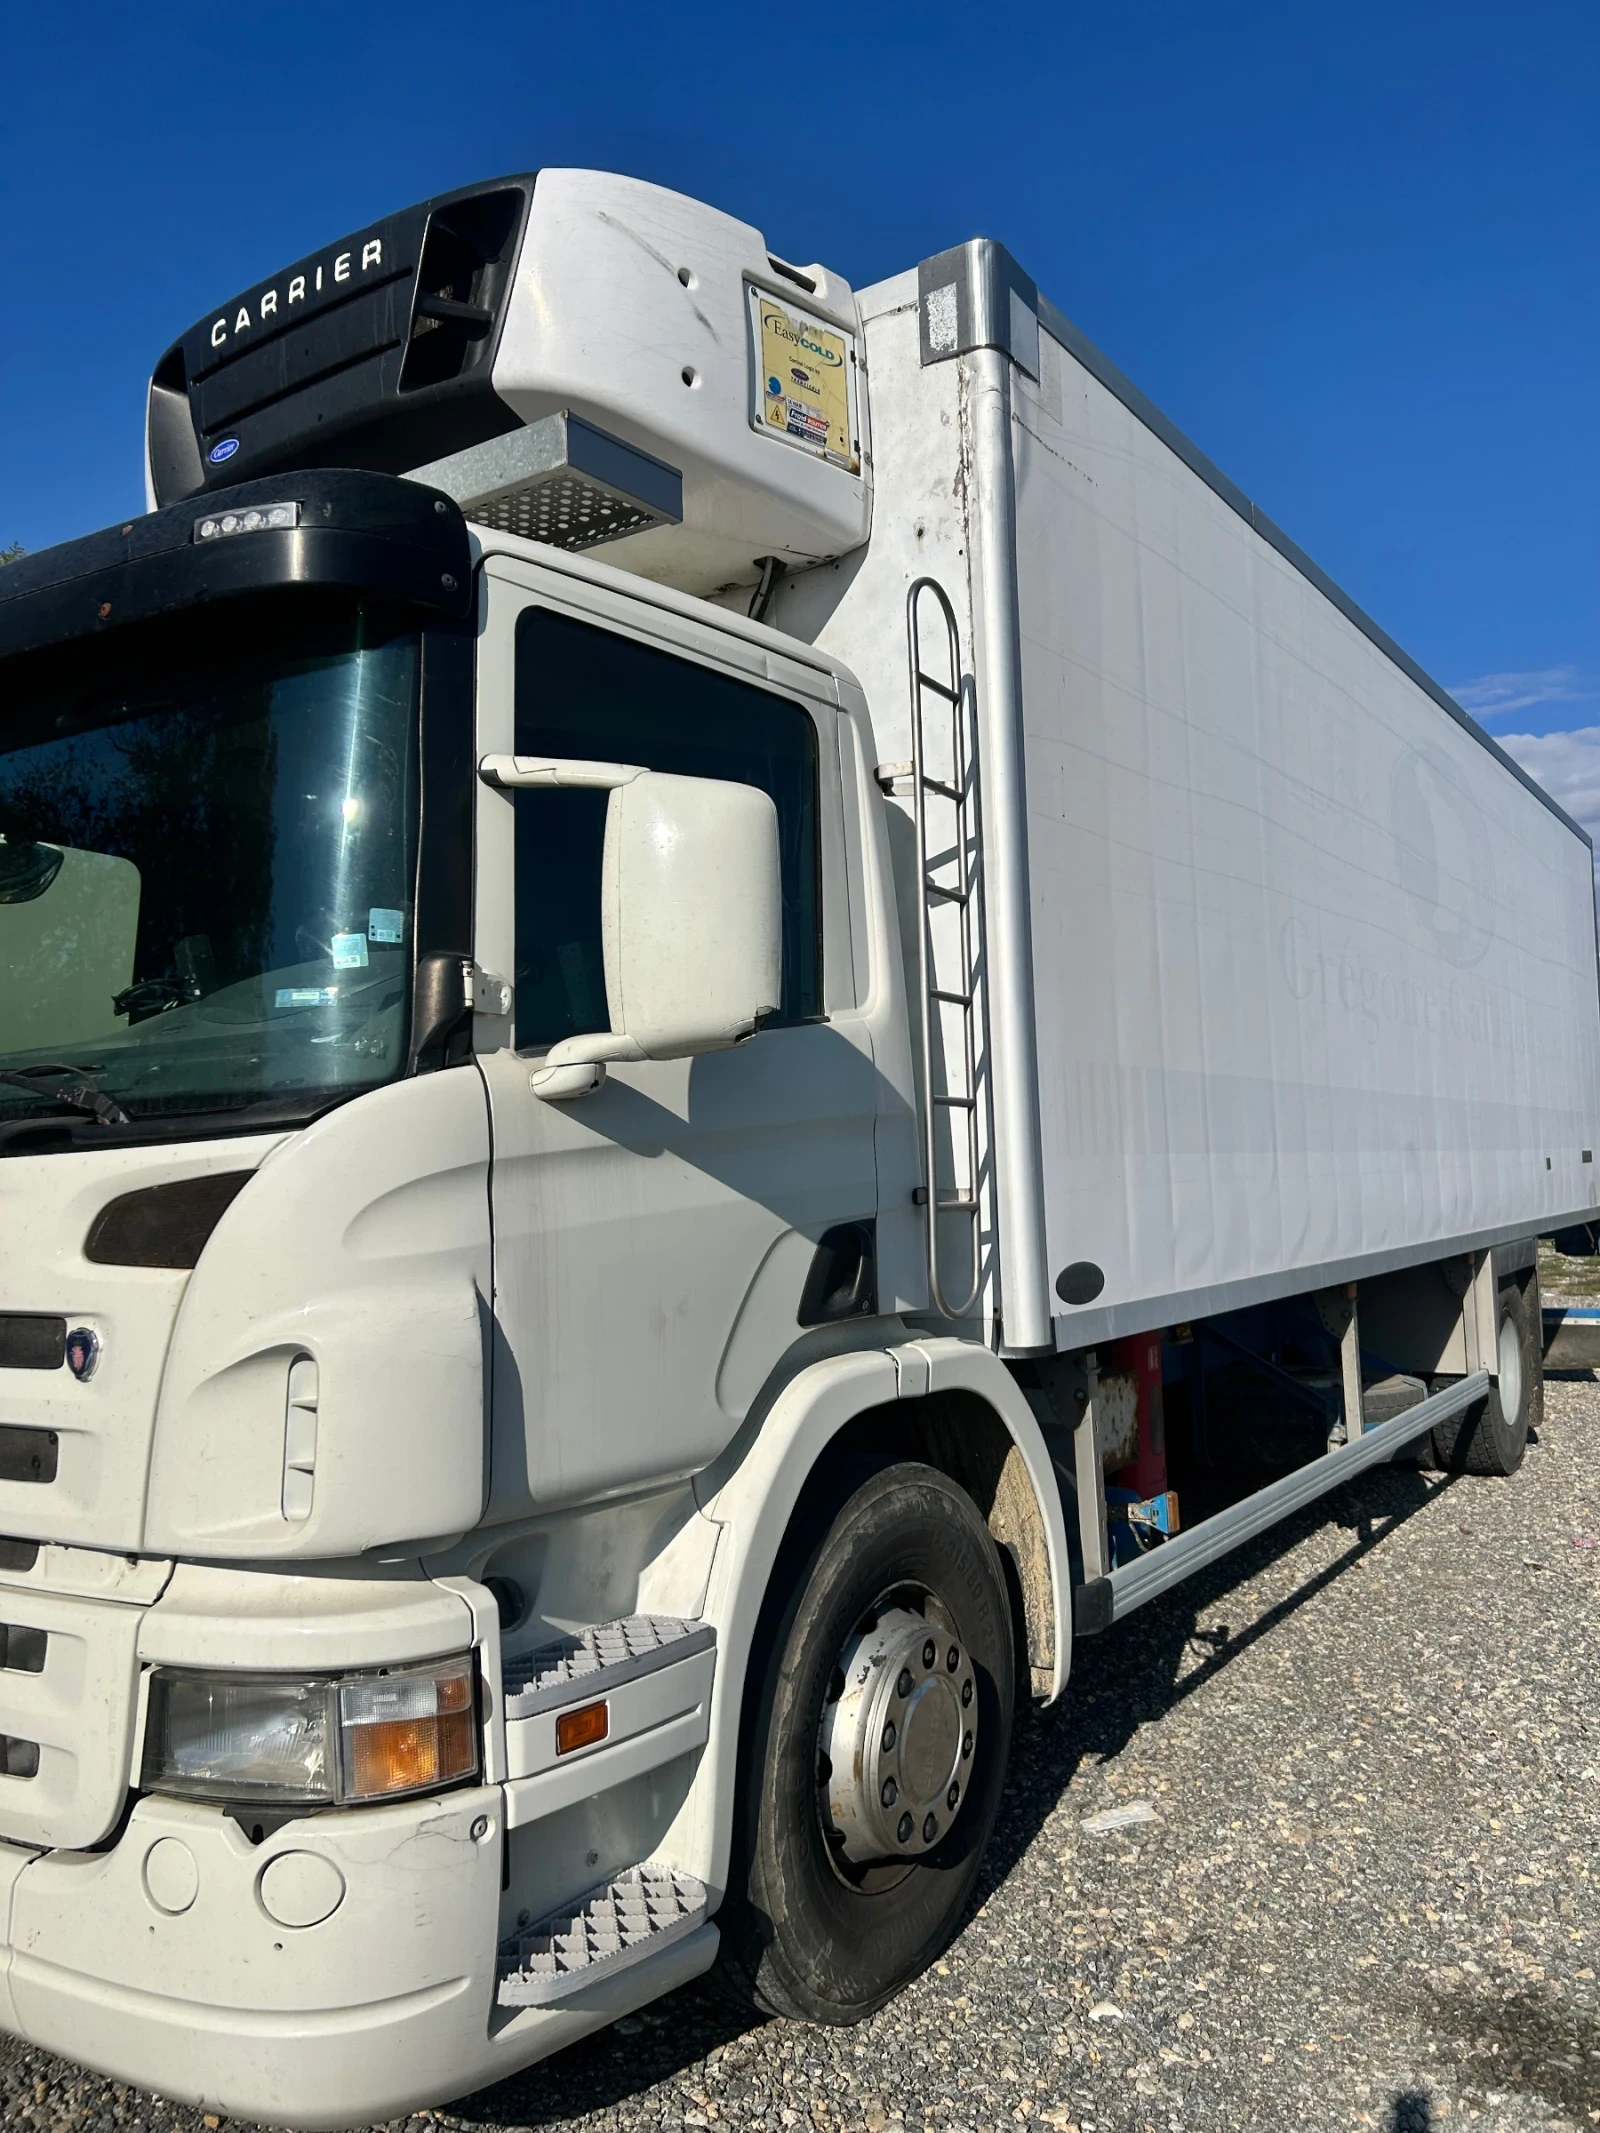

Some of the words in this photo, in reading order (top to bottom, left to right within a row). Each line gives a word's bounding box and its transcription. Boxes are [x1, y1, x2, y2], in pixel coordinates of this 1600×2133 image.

[211, 239, 382, 347] CARRIER
[773, 320, 835, 361] EasyCOLD
[212, 442, 237, 460] Carrier
